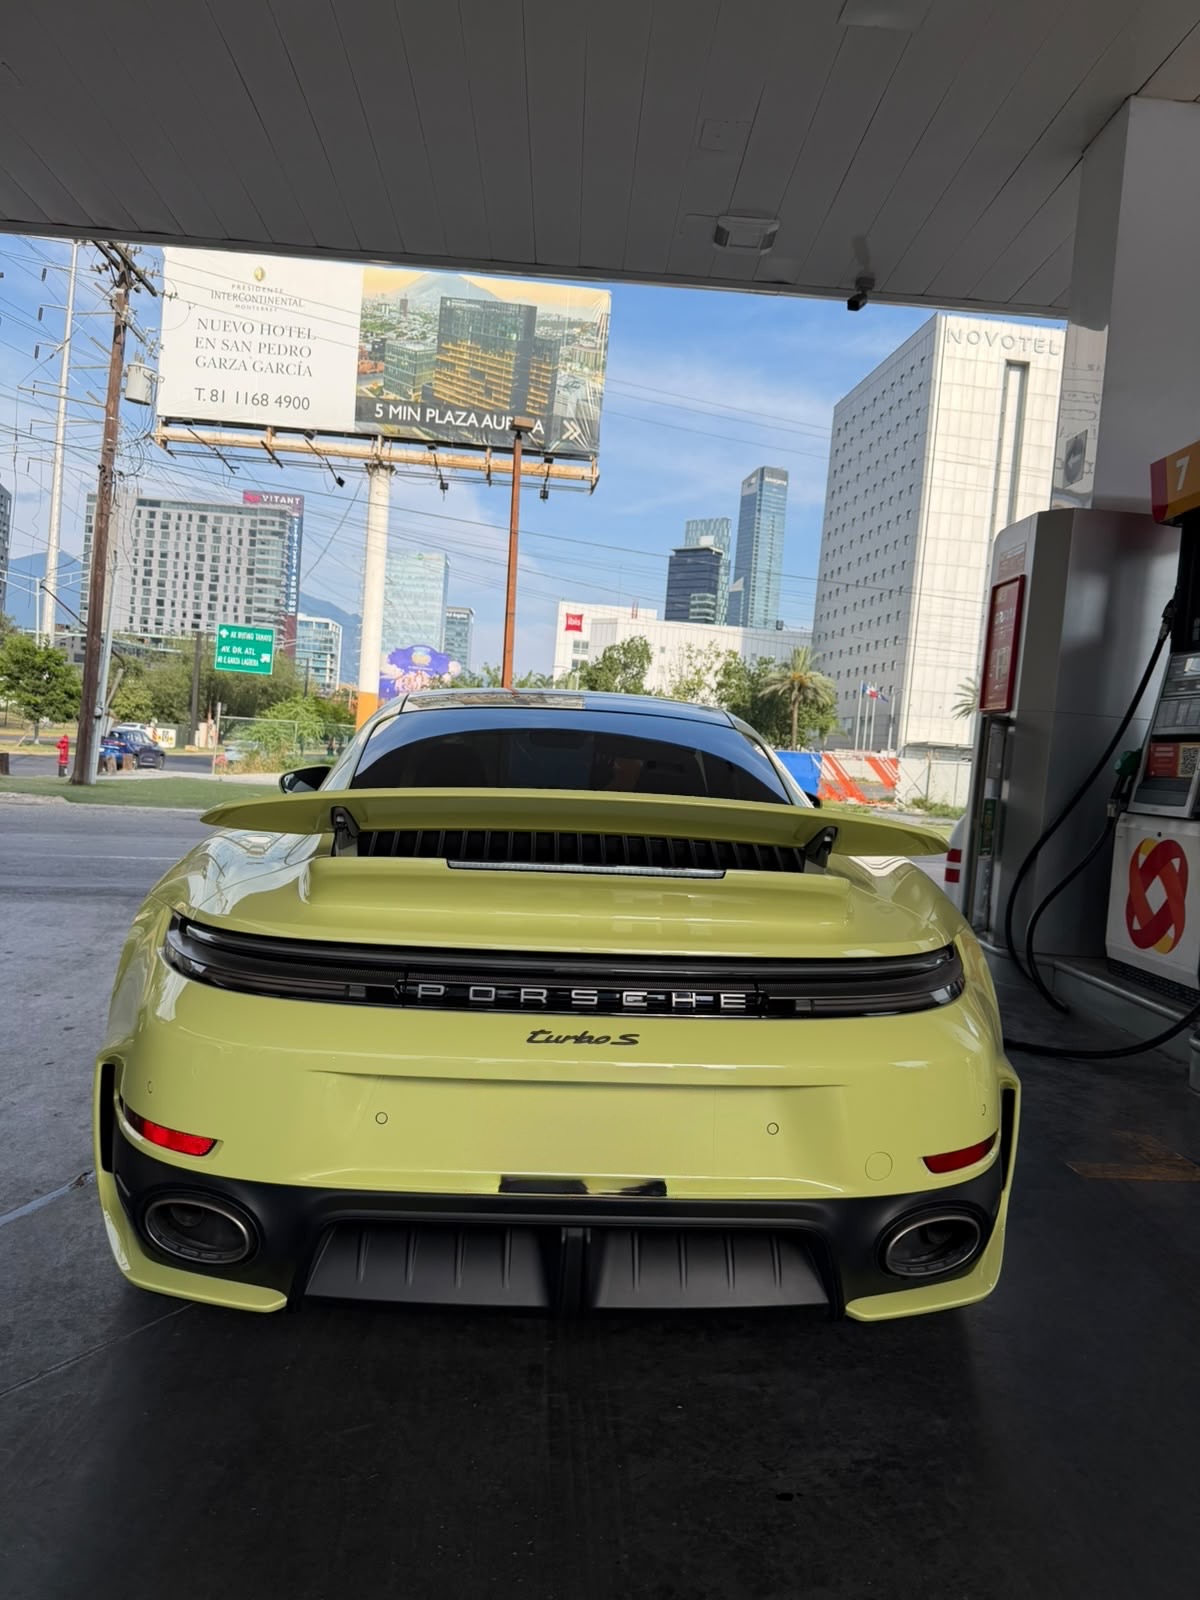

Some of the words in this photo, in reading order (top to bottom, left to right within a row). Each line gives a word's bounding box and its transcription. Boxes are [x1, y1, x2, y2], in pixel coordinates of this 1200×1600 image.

[231, 284, 284, 294] PRESIDENTE
[197, 318, 254, 335] NUEVO
[260, 323, 316, 340] HOTEL
[195, 336, 216, 350] EN
[221, 338, 252, 353] SAN
[258, 342, 312, 358] PEDRO
[946, 327, 1060, 356] NOVOTEL
[195, 355, 248, 371] GARZA
[252, 360, 313, 377] GARCÍA
[235, 391, 269, 407] 1168
[274, 394, 311, 411] 4900
[374, 403, 384, 418] 5
[388, 404, 421, 422] MIN
[425, 410, 479, 428] PLAZA
[1175, 455, 1191, 491] 7
[262, 494, 300, 505] VITANT
[417, 983, 747, 1009] PORSCHE
[526, 1028, 612, 1046] turbo
[610, 1033, 641, 1046] S
